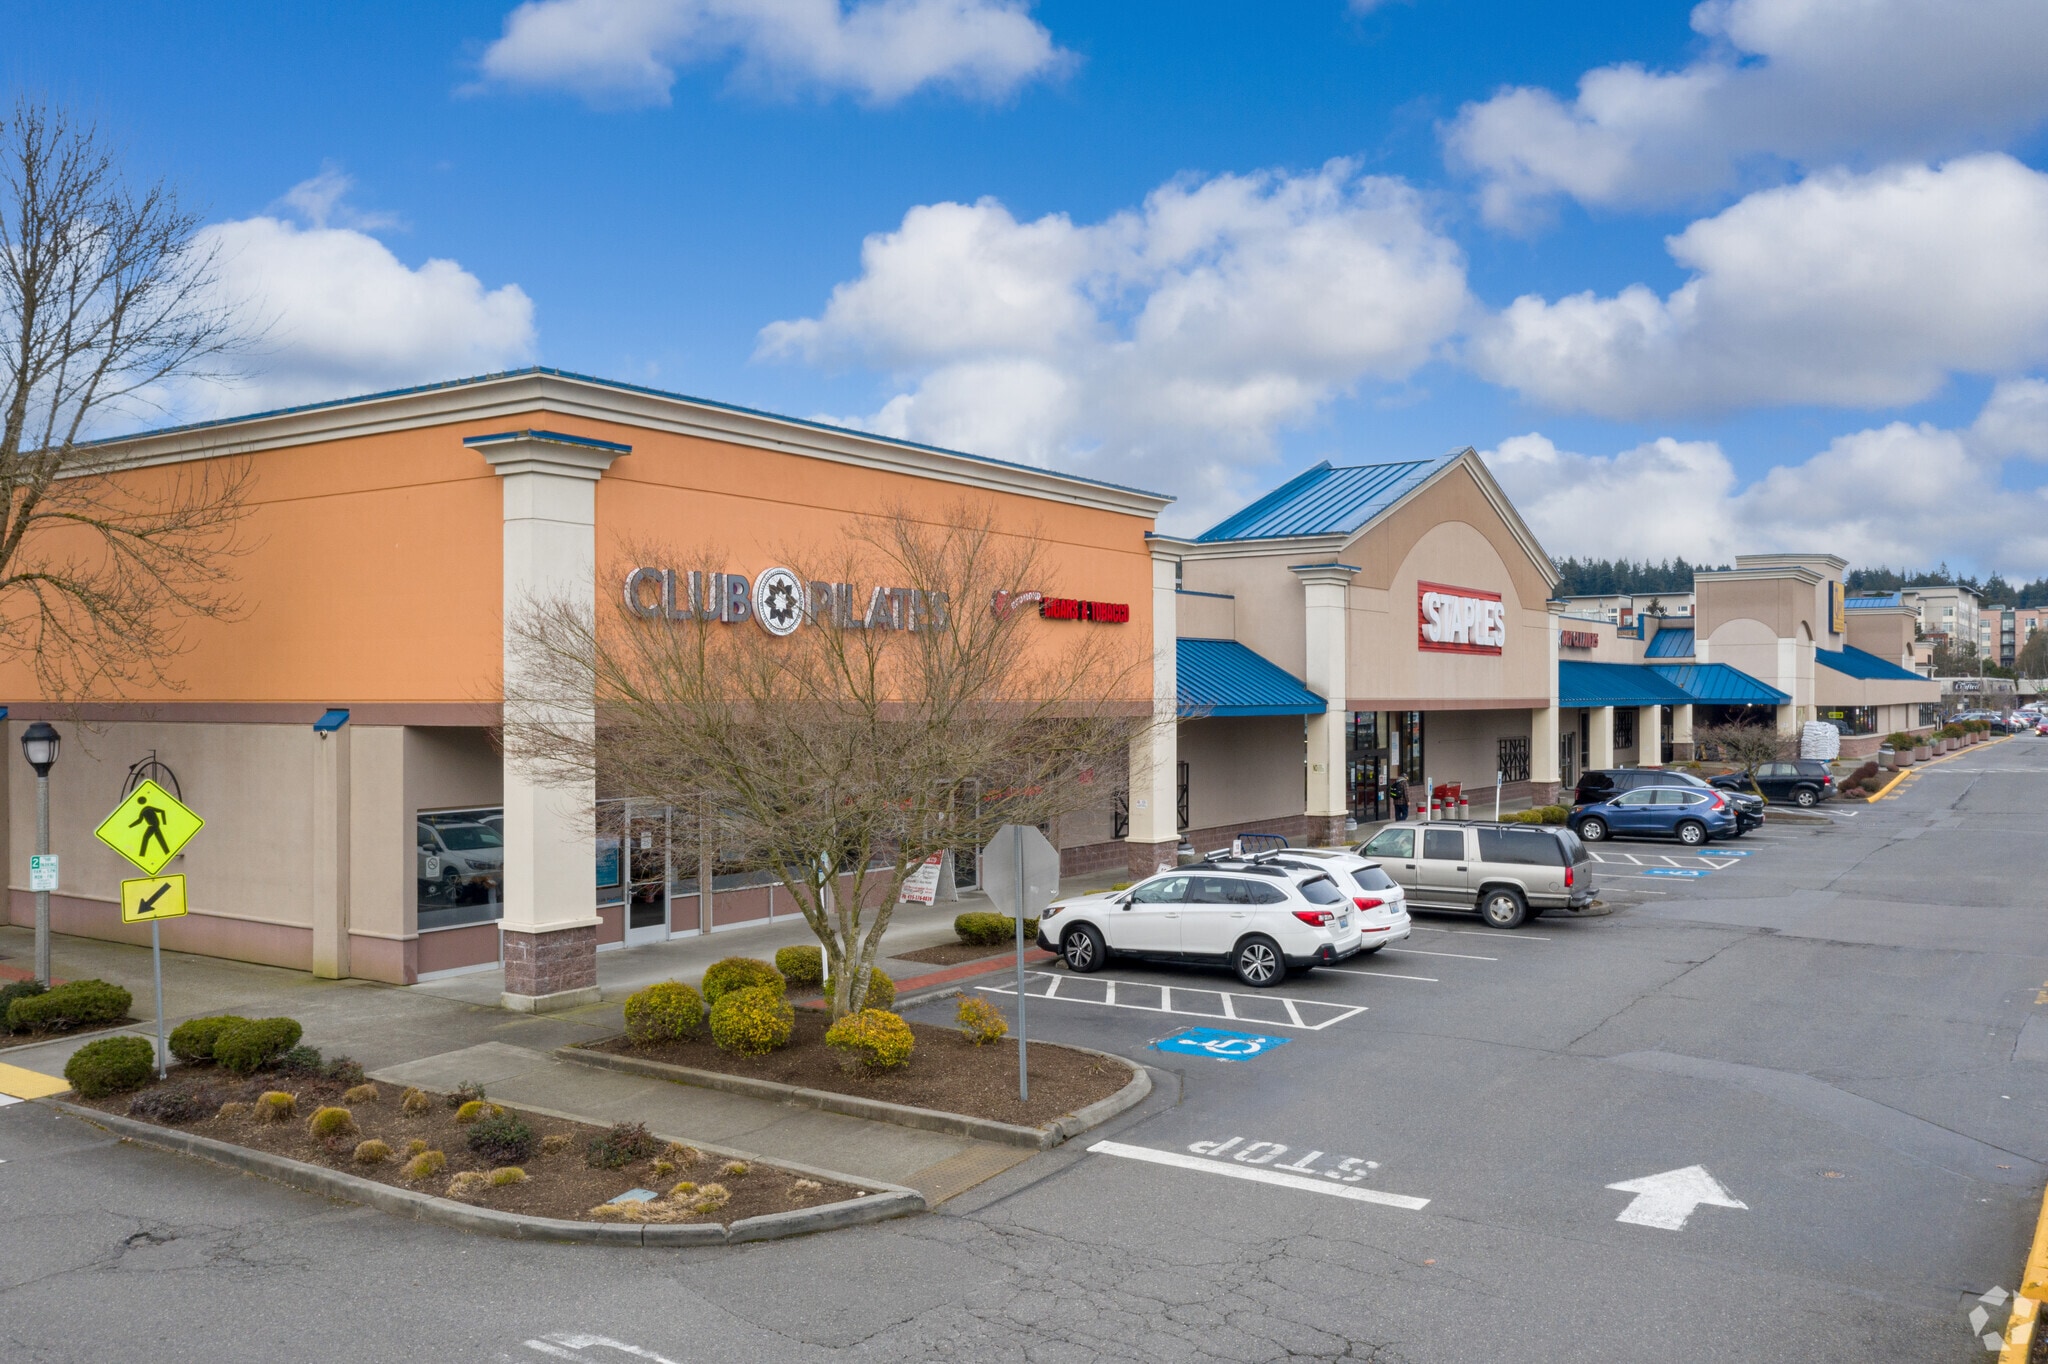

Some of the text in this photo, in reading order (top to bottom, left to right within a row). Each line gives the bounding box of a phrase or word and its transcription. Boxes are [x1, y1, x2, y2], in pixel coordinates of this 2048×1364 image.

[624, 567, 950, 633] CLUB PILATES
[1042, 596, 1129, 623] CIGARS & TOBACCO
[1422, 592, 1505, 647] STAPLES
[32, 858, 39, 868] 2
[1187, 1136, 1381, 1182] STOP
